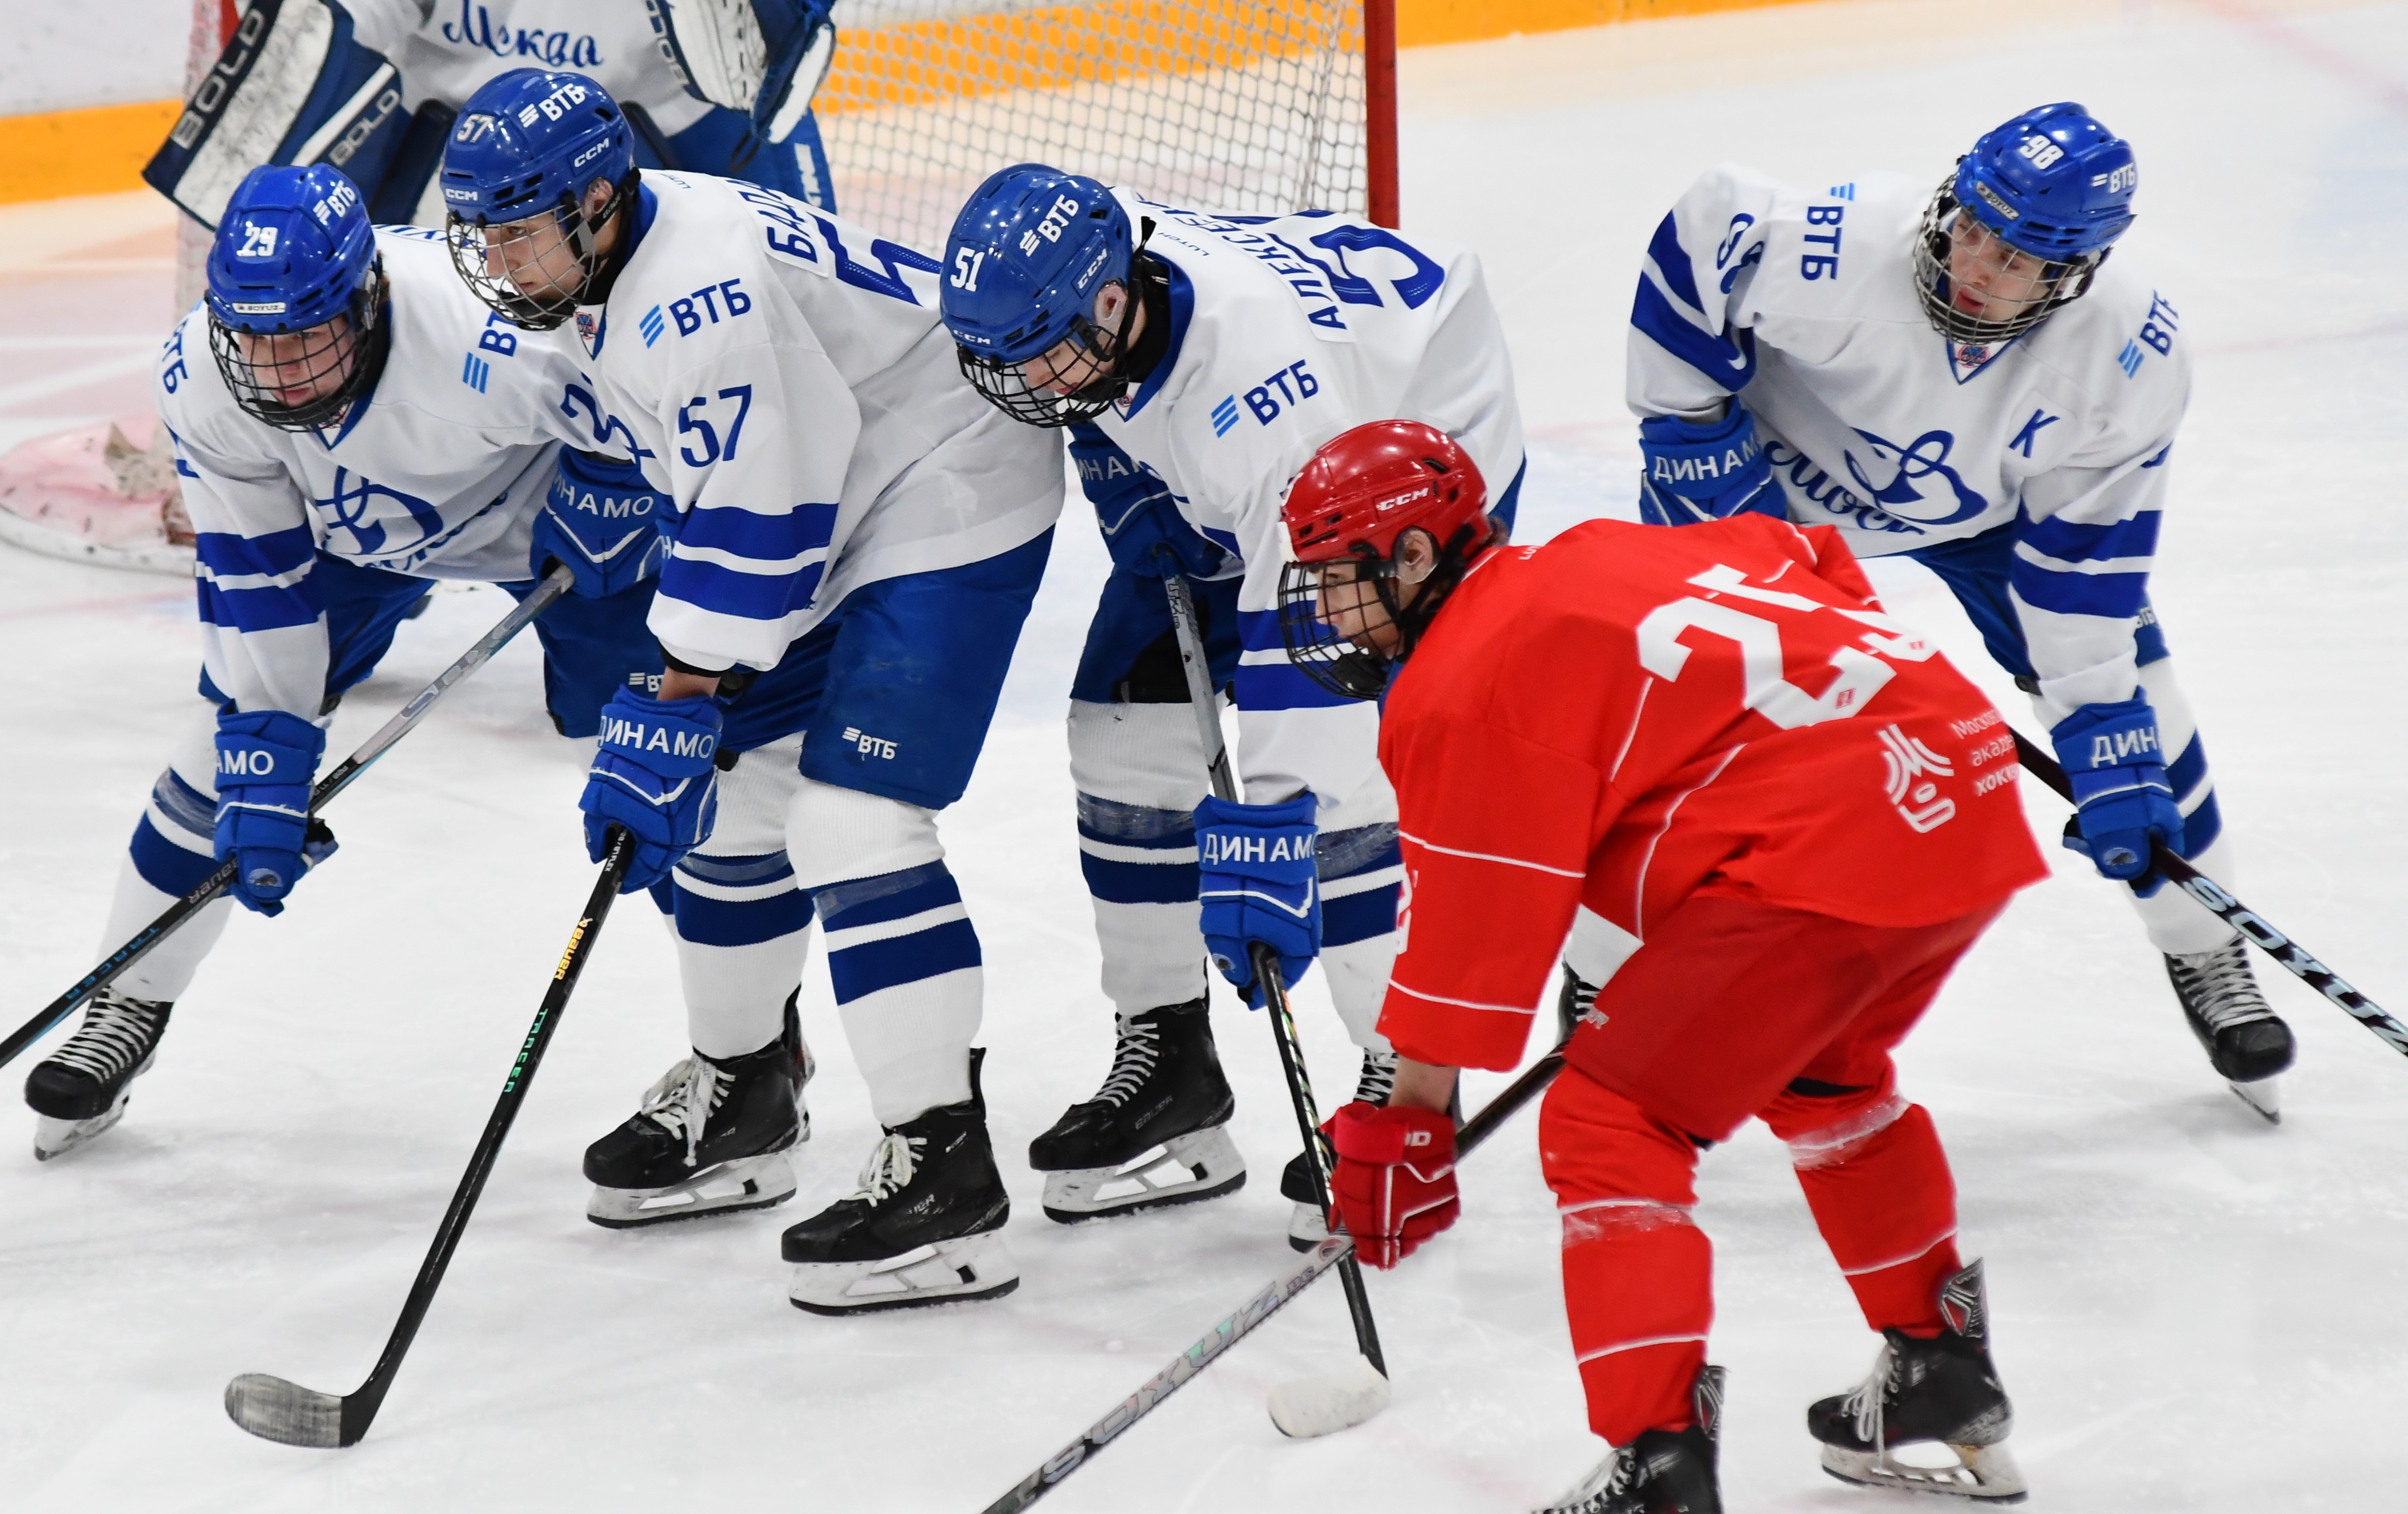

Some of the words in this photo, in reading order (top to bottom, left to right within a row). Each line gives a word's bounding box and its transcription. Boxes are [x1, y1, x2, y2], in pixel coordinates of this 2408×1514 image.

[171, 7, 265, 150] BOLD
[538, 83, 586, 121] ВТБ
[329, 88, 400, 164] BOLD
[457, 114, 495, 143] 57
[573, 137, 611, 168] CCM
[2020, 135, 2064, 170] 98
[445, 188, 478, 202] CCM
[2109, 162, 2135, 193] ВТБ
[326, 181, 356, 218] ВТБ
[1037, 194, 1079, 243] ВТБ
[237, 226, 278, 257] 29
[1801, 205, 1844, 280] ВТБ
[950, 246, 985, 292] 51
[1077, 248, 1107, 289] CCM
[669, 278, 751, 337] ВТБ
[479, 310, 518, 357] ВТ
[953, 329, 991, 345] CCM
[1243, 359, 1318, 426] ВТБ
[678, 384, 751, 467] 57
[1376, 487, 1429, 511] CCM
[598, 715, 715, 759] ДИНАМО
[857, 735, 898, 760] ВТБ
[2092, 728, 2161, 768] ДИН
